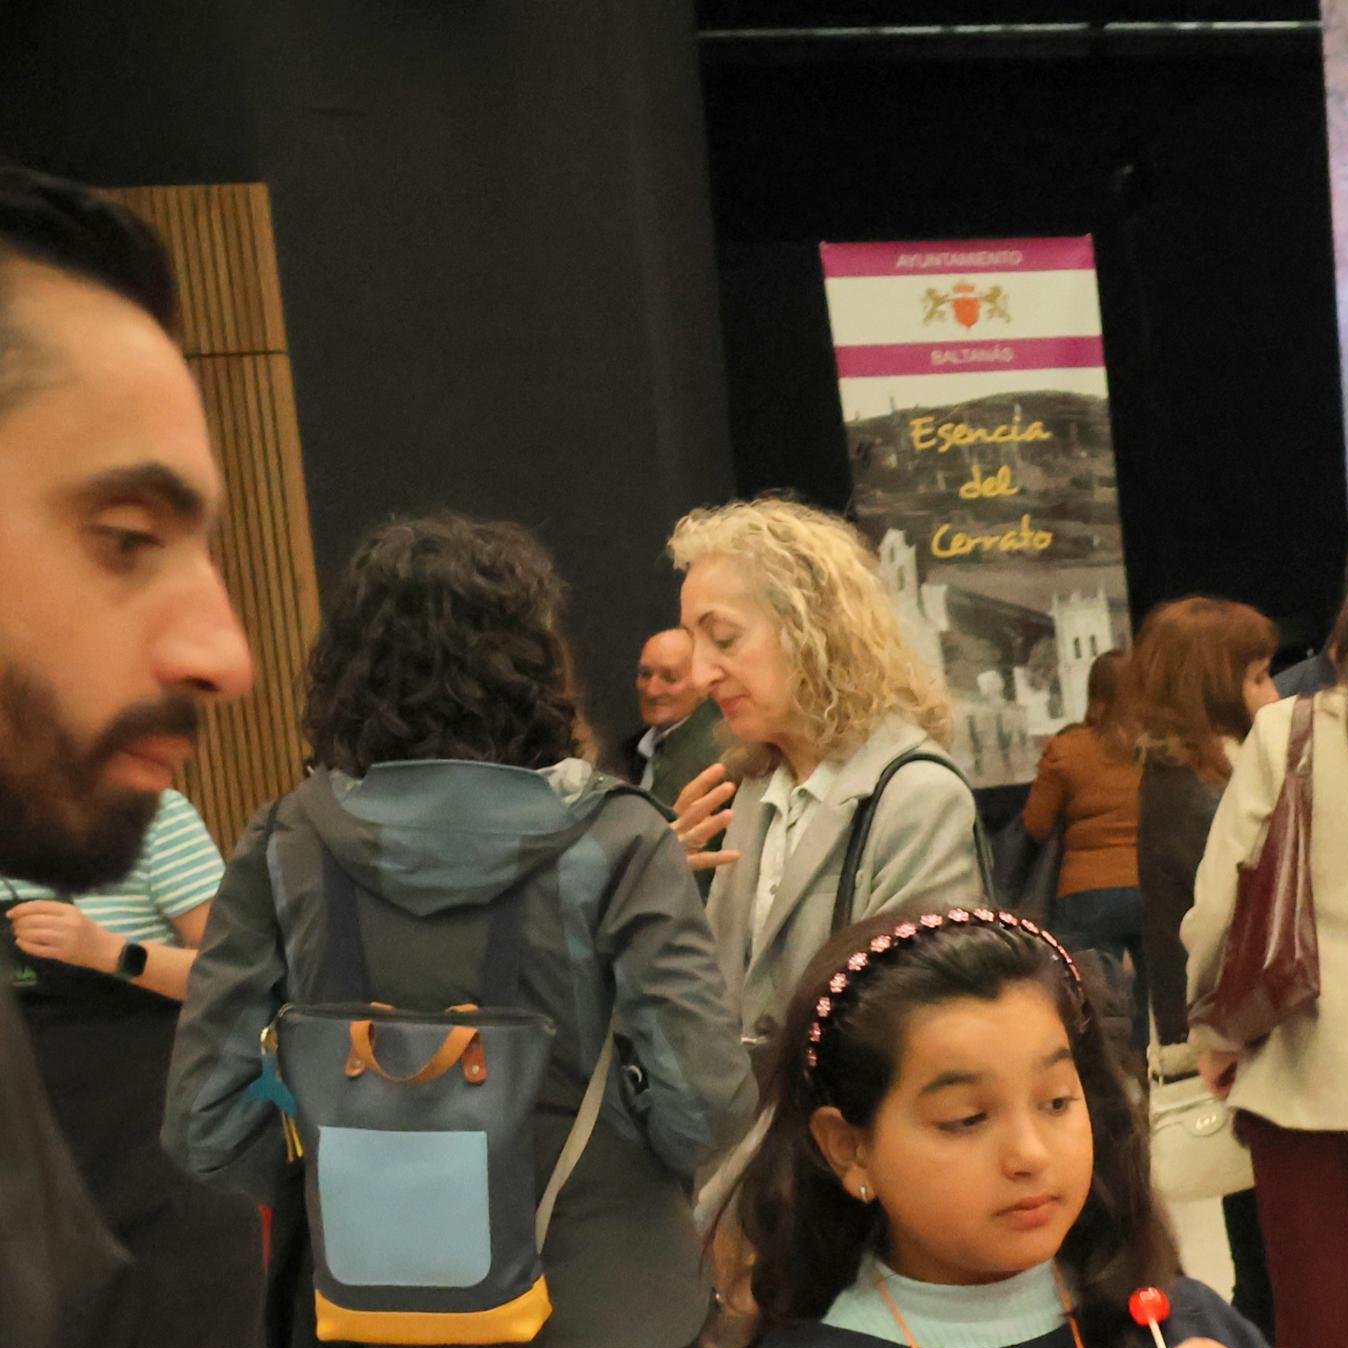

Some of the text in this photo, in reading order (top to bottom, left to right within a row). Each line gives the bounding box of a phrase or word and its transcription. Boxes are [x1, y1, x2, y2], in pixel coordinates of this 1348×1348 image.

[896, 249, 1023, 269] AYUNTAMIENTO
[930, 345, 1014, 366] BALTANÁS
[910, 415, 1053, 451] Esencia
[958, 463, 1018, 501] del
[931, 512, 1054, 559] Cerrato
